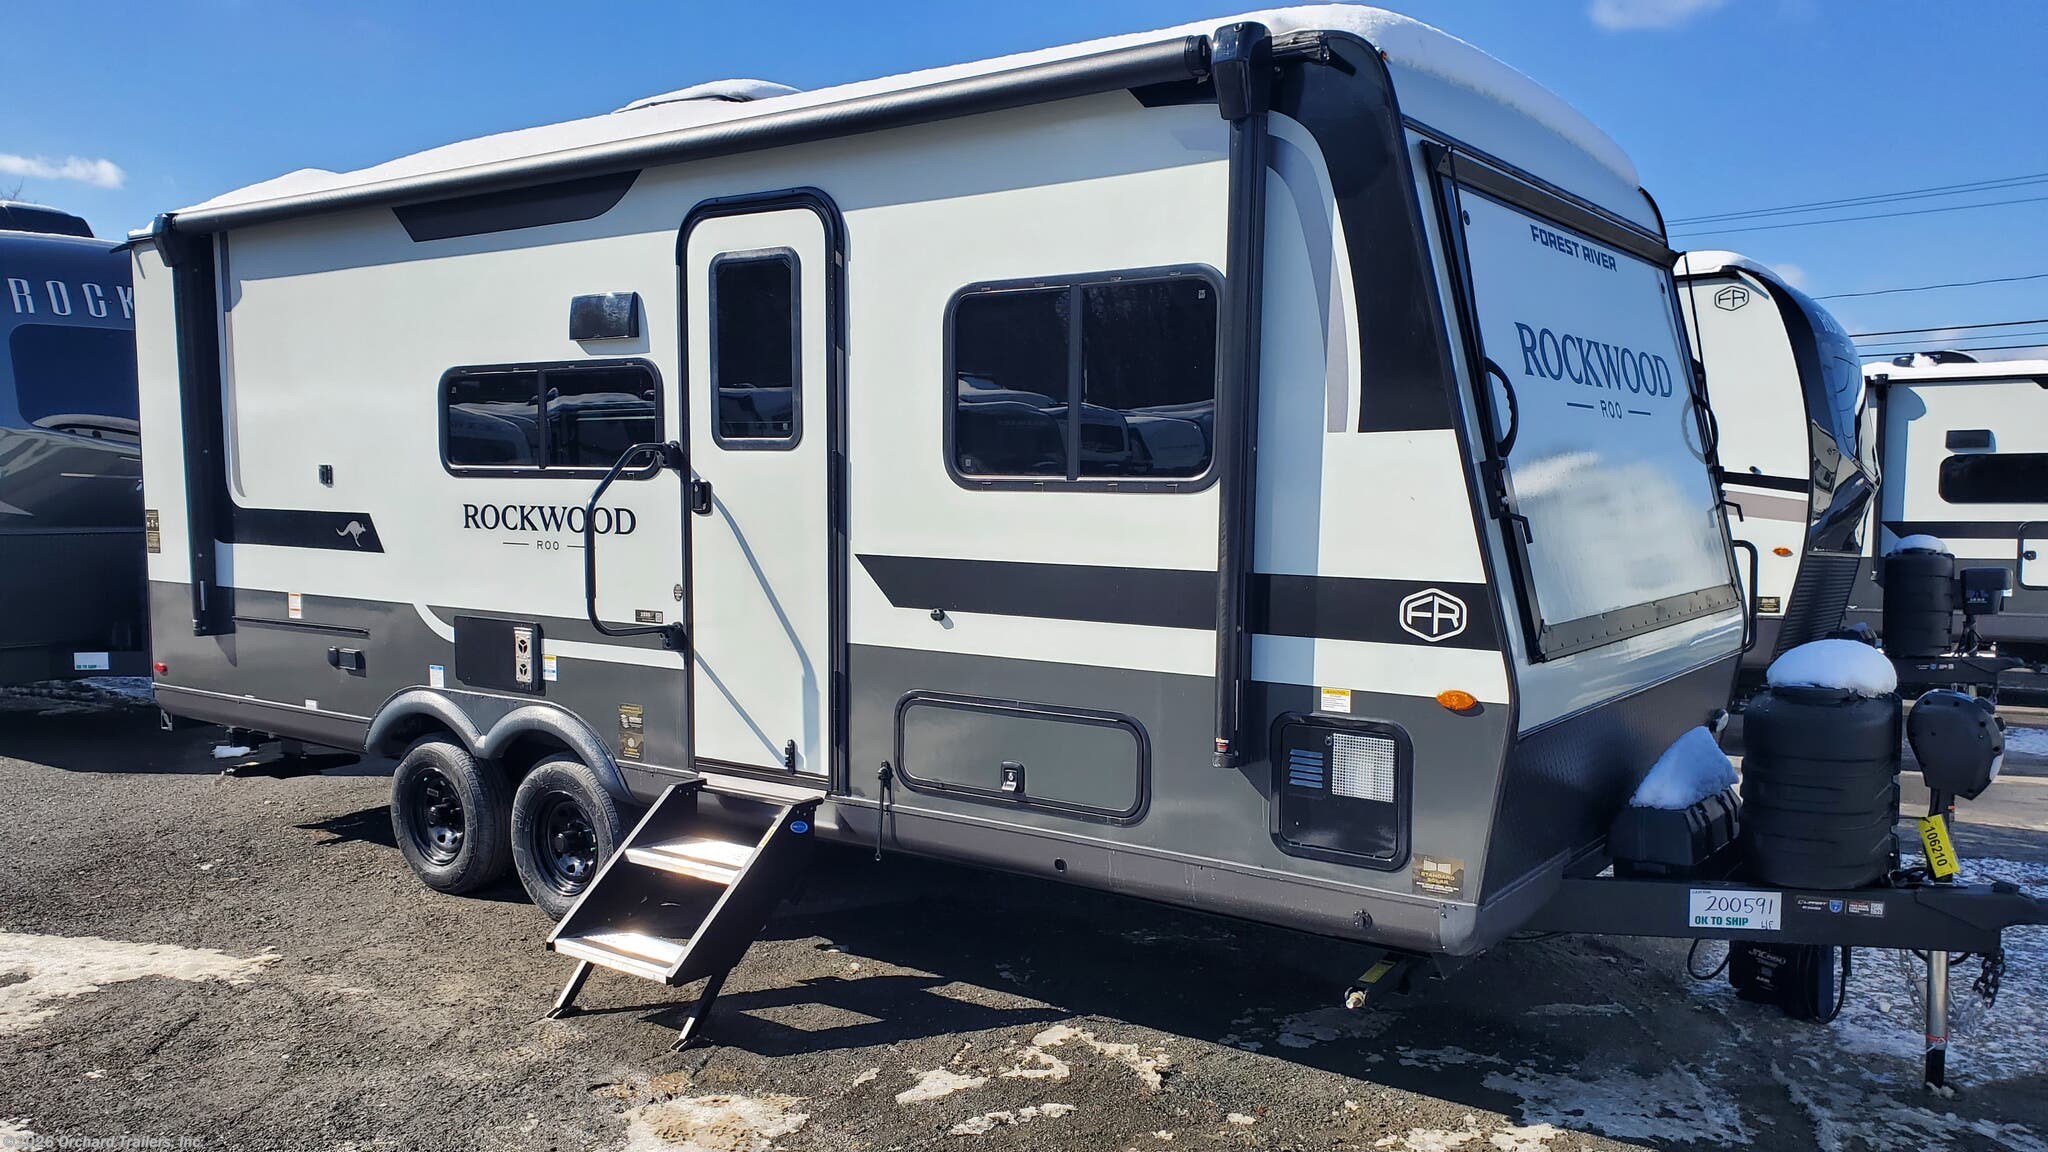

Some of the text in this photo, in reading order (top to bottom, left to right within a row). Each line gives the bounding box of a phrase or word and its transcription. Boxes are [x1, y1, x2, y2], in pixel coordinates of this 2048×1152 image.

[1530, 224, 1617, 272] FOREST RIVER
[1514, 322, 1673, 398] ROCKWOOD
[1600, 400, 1622, 419] ROO
[463, 504, 636, 535] ROCKWOOD
[537, 541, 559, 550] ROO
[1925, 827, 1948, 866] 106210
[1704, 895, 1774, 914] 200591
[1694, 915, 1749, 926] OK TO SHIP
